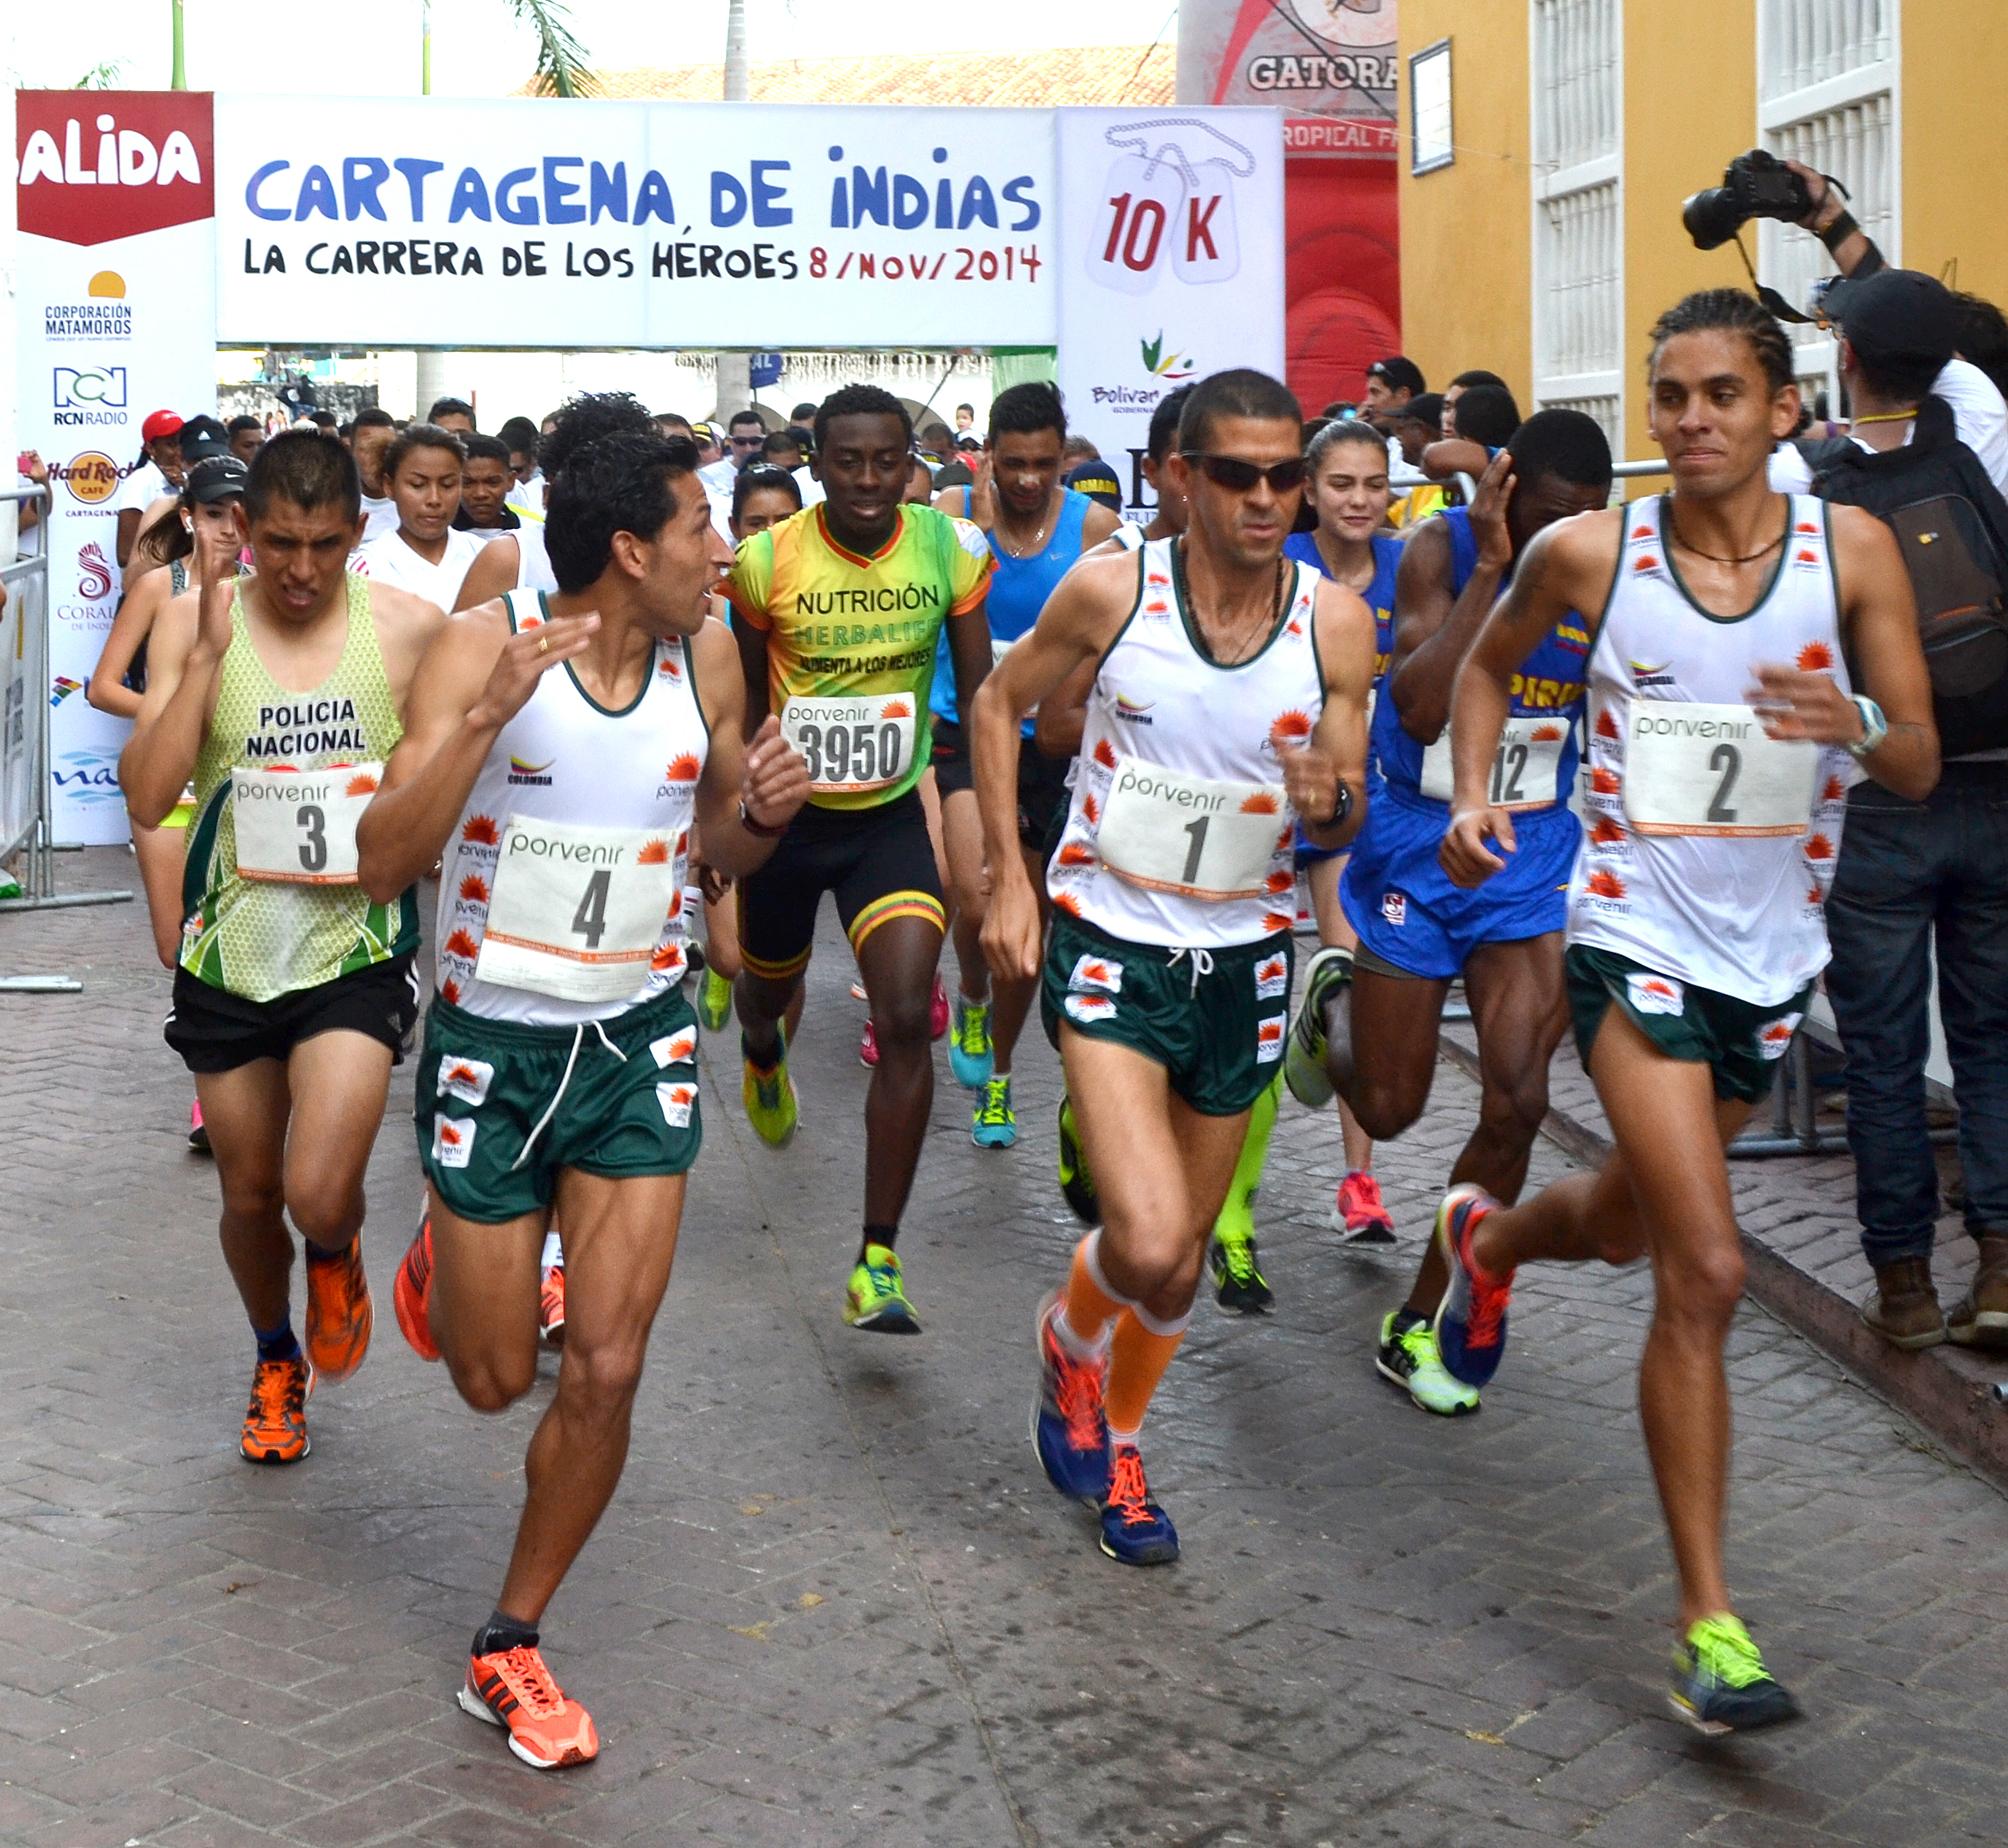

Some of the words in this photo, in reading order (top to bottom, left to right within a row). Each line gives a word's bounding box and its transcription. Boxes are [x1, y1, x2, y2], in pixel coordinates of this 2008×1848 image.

[245, 156, 675, 226] CARTAGENA
[711, 160, 793, 227] DE
[1103, 192, 1167, 271] 10
[1186, 195, 1223, 262] K
[244, 238, 286, 274] LA
[306, 240, 483, 275] CARRERA
[503, 241, 546, 276] DE
[565, 241, 634, 278] LOS
[652, 225, 799, 279] HÉROES
[45, 302, 132, 318] CORPORACIÓN
[45, 320, 132, 334] MATAMOROS
[47, 462, 94, 480] Hard
[796, 582, 940, 614] NUTRICIÓN
[866, 656, 886, 673] LOS
[260, 699, 355, 729] POLICIA
[788, 707, 869, 724] porvenir
[1635, 716, 1753, 740] porvenir
[247, 729, 365, 757] NACIONAL
[799, 722, 901, 783] 3950
[237, 781, 330, 803] porvenir
[507, 774, 553, 786] COLOMBIA
[1118, 768, 1227, 811] porvenir
[1707, 744, 1742, 823] 2
[296, 804, 327, 872] 3
[509, 831, 624, 866] porvenir
[1182, 815, 1211, 883] 1
[571, 870, 612, 950] 4
